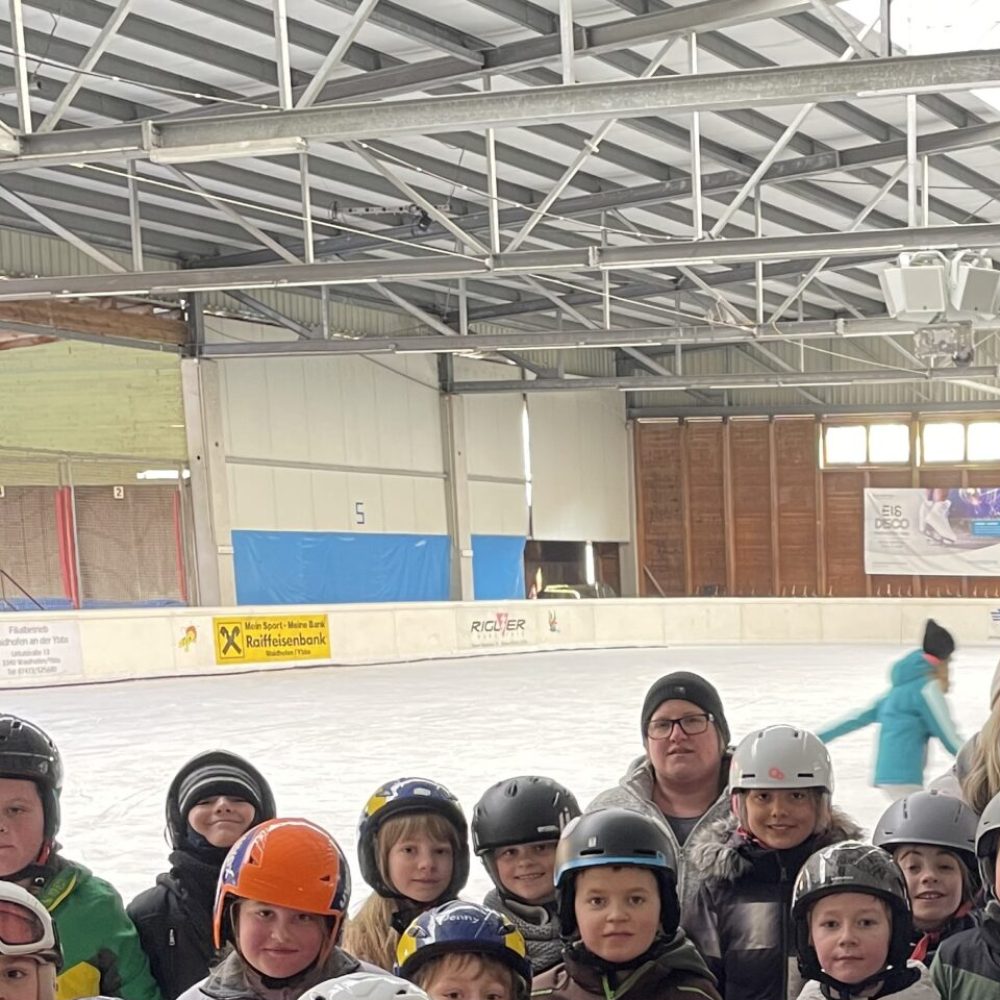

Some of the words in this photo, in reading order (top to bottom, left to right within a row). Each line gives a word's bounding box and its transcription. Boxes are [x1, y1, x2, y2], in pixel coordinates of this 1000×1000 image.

[245, 622, 261, 630] Mein
[263, 621, 283, 631] Sport
[288, 621, 307, 629] Meine
[309, 620, 326, 629] Bank
[246, 632, 326, 648] Raiffeisenbank
